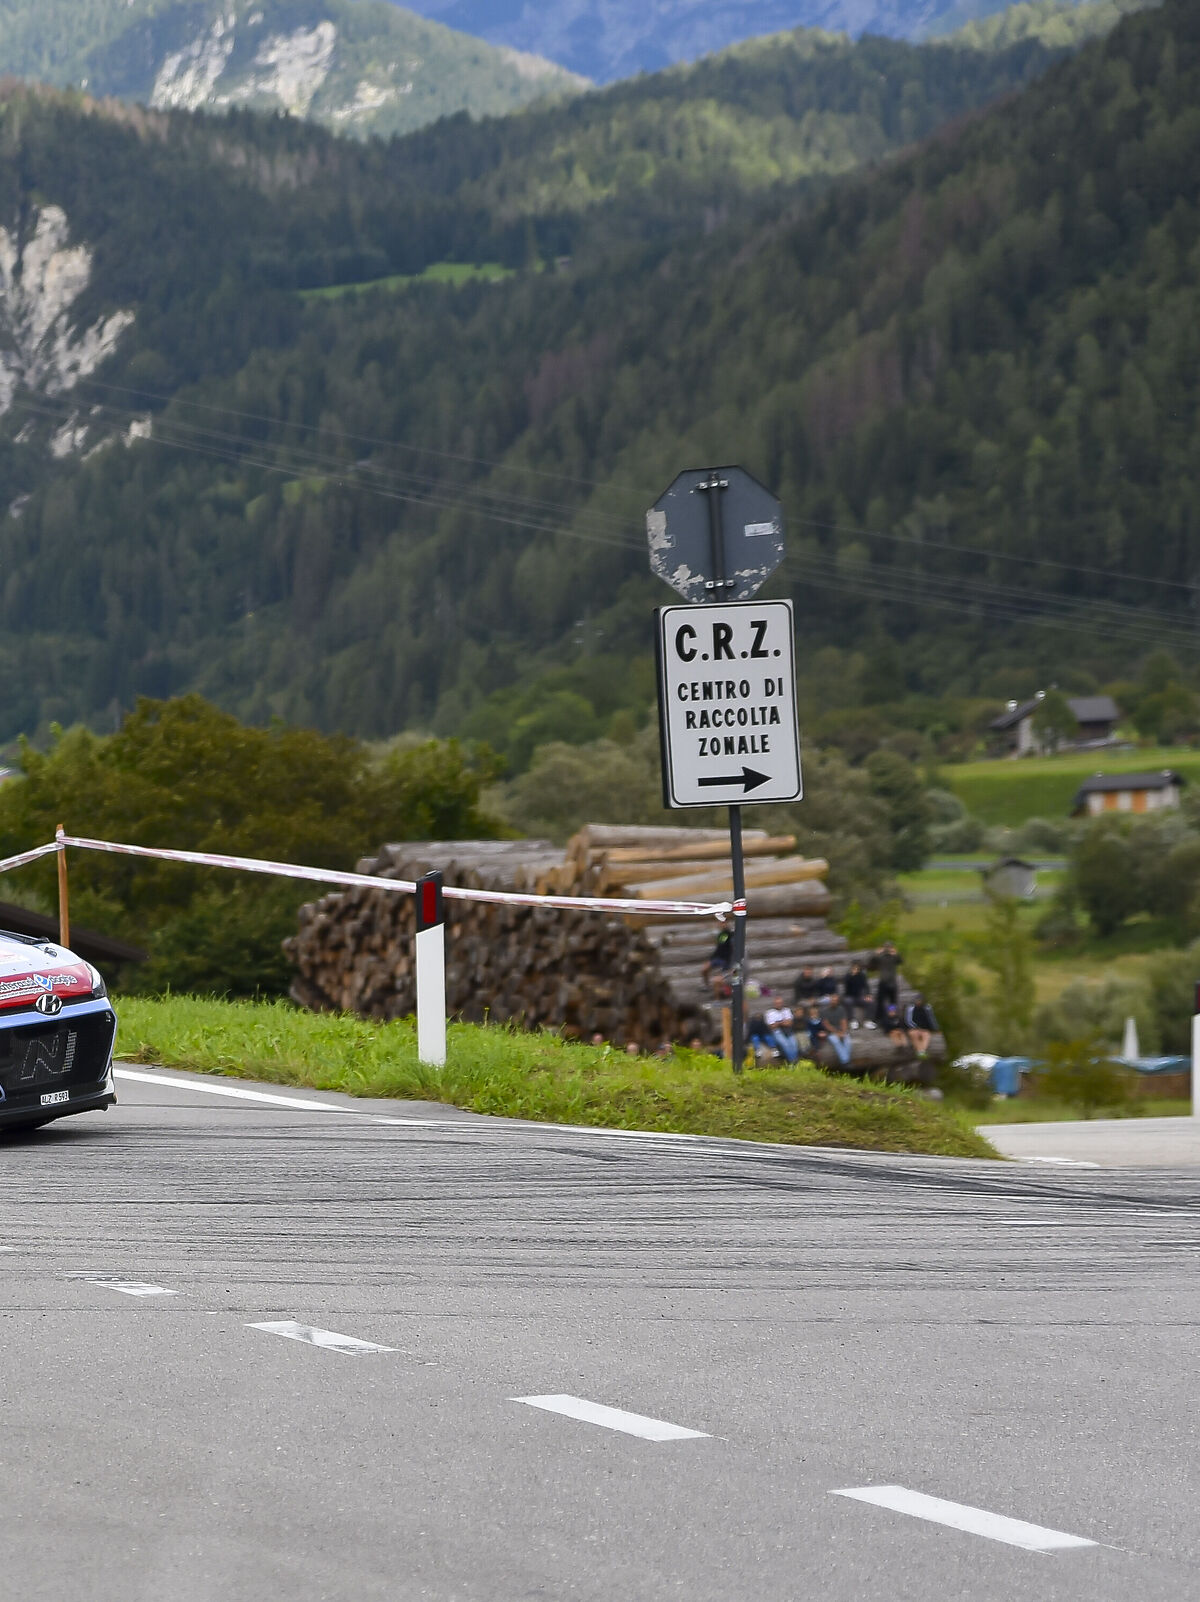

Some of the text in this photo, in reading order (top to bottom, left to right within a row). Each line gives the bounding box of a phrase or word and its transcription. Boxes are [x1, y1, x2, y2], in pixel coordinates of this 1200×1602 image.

[675, 620, 781, 662] C.R.Z.
[677, 677, 784, 701] CENTRO DI
[685, 706, 781, 729] RACCOLTA
[698, 734, 771, 757] ZONALE
